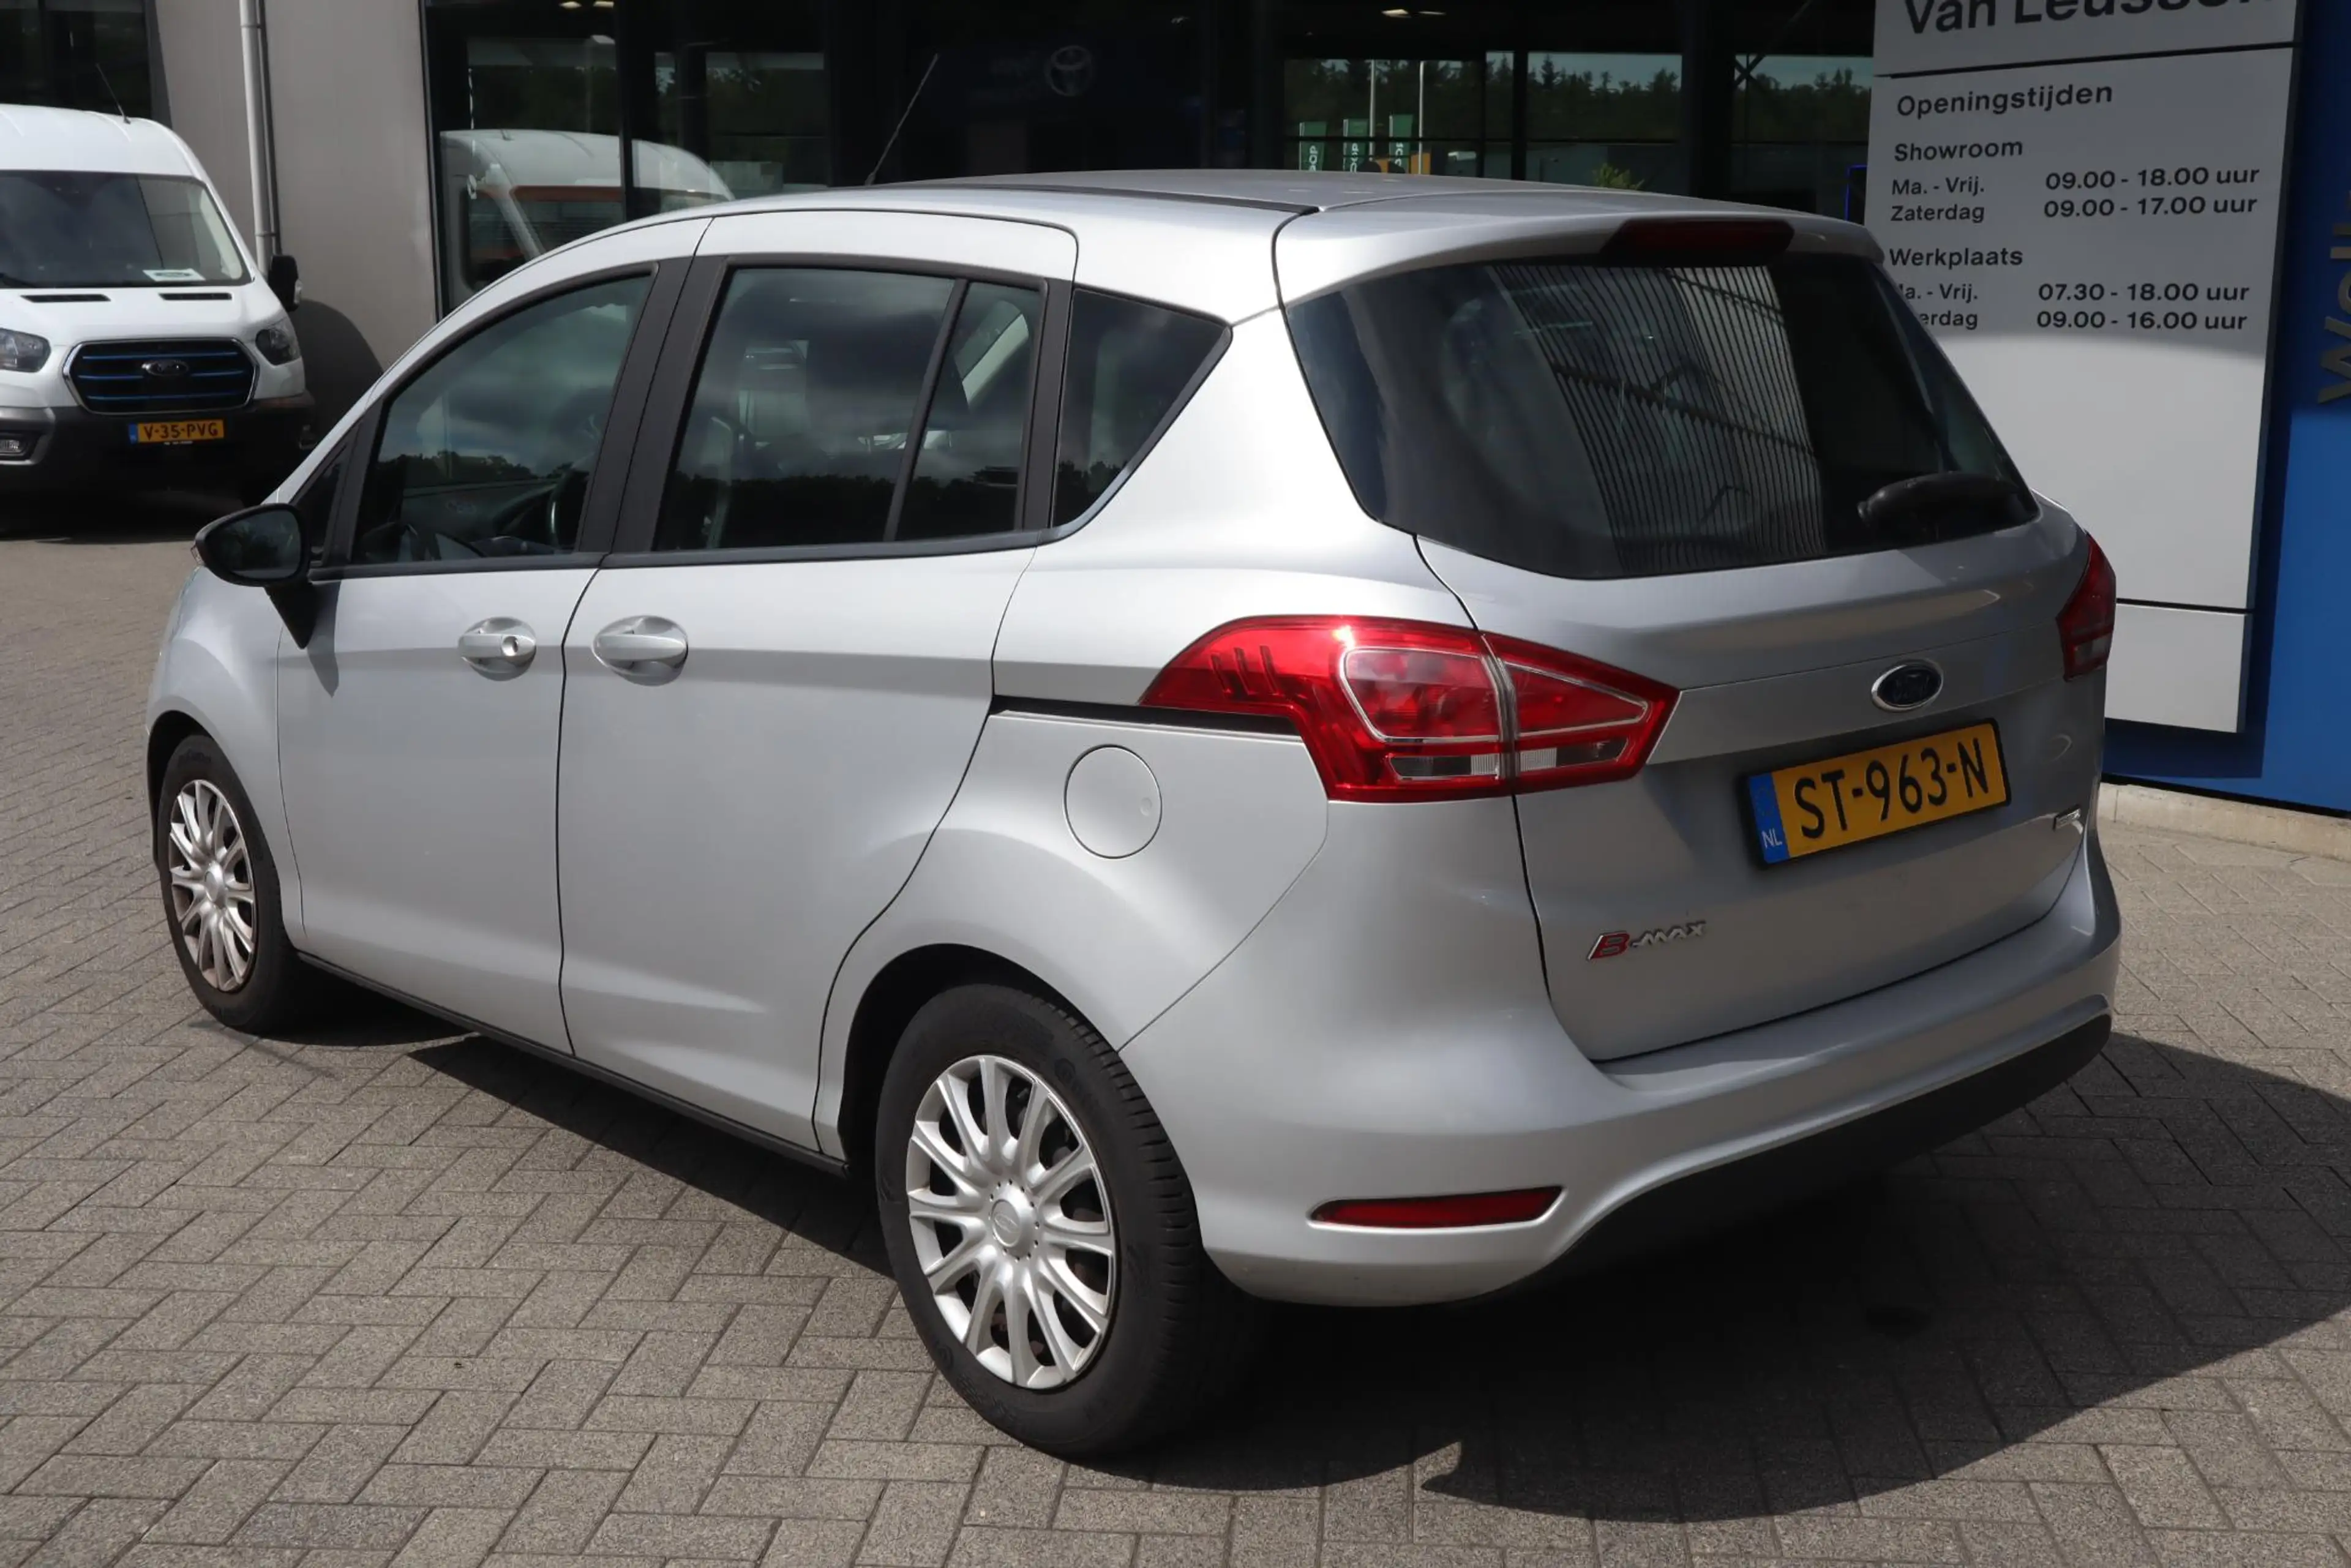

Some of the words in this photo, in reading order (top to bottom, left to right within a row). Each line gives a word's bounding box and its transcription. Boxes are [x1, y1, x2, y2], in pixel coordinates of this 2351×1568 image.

[1904, 0, 1996, 34] Van
[1897, 84, 2113, 120] Openingstijden
[1894, 141, 2023, 162] Showroom
[1891, 179, 1928, 195] Ma.
[1945, 176, 1985, 197] Vrij.
[2045, 170, 2116, 190] 09.00
[2137, 167, 2209, 186] 18.00
[2216, 167, 2260, 184] uur
[1890, 204, 1985, 223] Zaterdag
[2044, 198, 2115, 218] 09.00
[2137, 196, 2206, 215] 17.00
[2213, 198, 2258, 214] uur
[1889, 247, 2024, 270] Werkplaats
[1899, 283, 1922, 300] a.
[1939, 283, 1978, 304] Vrij.
[2038, 283, 2105, 301] 07.30
[2127, 283, 2199, 301] 18.00
[2206, 286, 2250, 301] uur
[2036, 310, 2105, 329] 09.00
[2127, 311, 2198, 329] 16.00
[2204, 315, 2248, 329] uur
[143, 422, 219, 441] V-35-PVG
[1793, 738, 1989, 839] ST-963-N
[1761, 829, 1783, 849] NL
[1586, 920, 1706, 961] B-MAX
